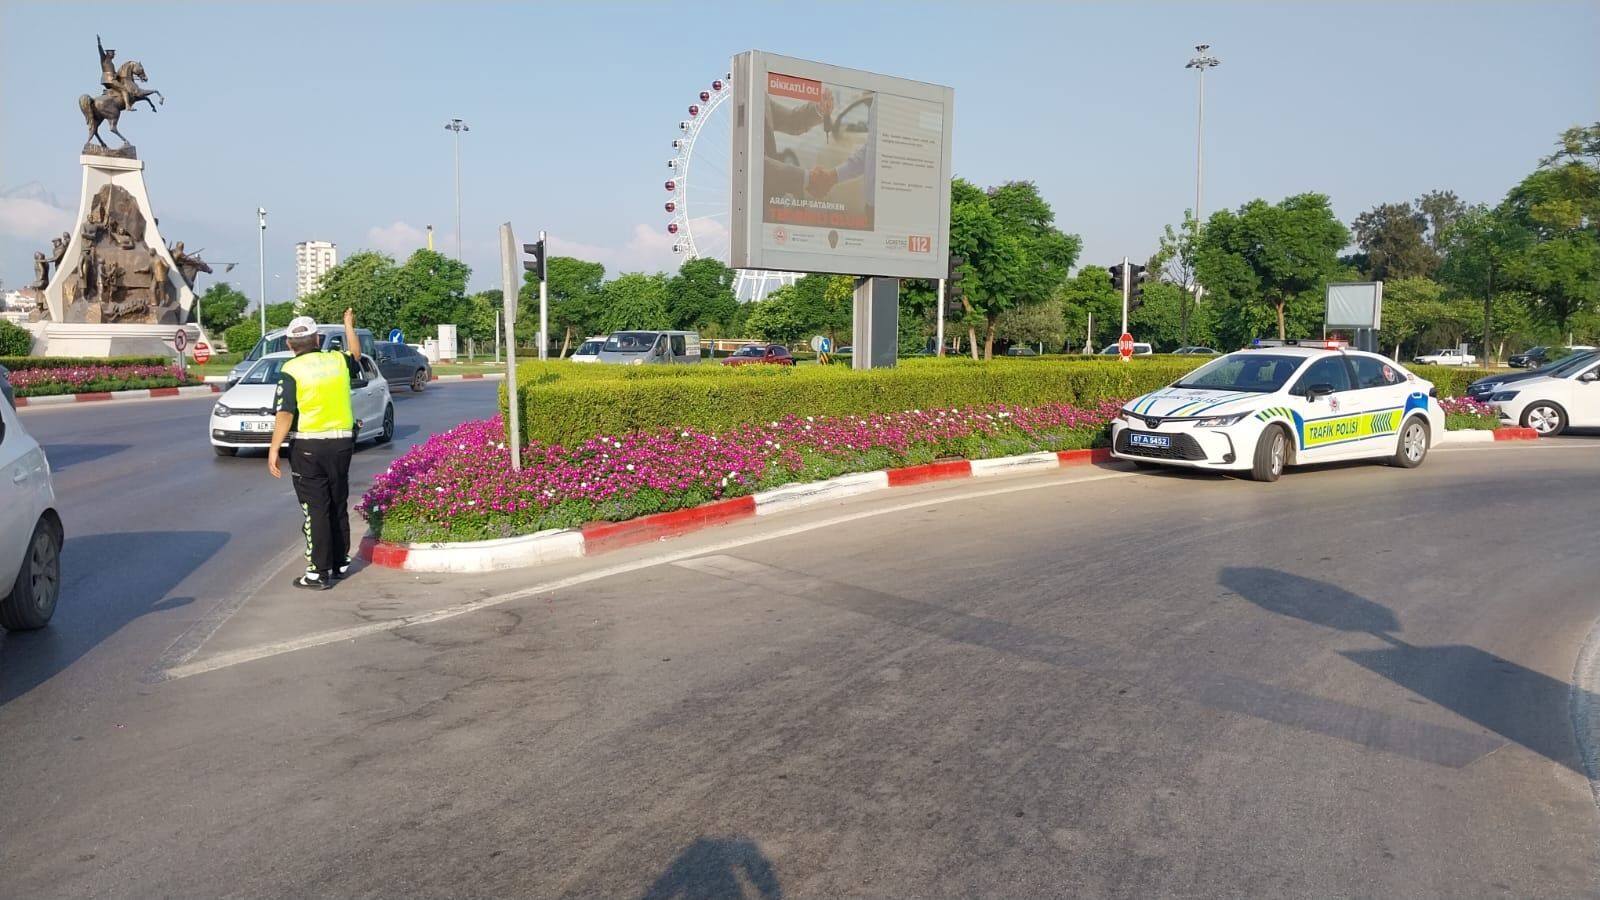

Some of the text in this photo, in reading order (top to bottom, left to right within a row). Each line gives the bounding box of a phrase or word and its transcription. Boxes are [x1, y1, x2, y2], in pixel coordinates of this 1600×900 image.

[770, 78, 805, 93] DİKKATLİ
[769, 196, 790, 208] ARAÇ
[791, 199, 807, 208] ALIP
[912, 236, 928, 252] 112
[1120, 340, 1133, 350] DUR
[1309, 420, 1358, 440] TRAFİK POLİSİ
